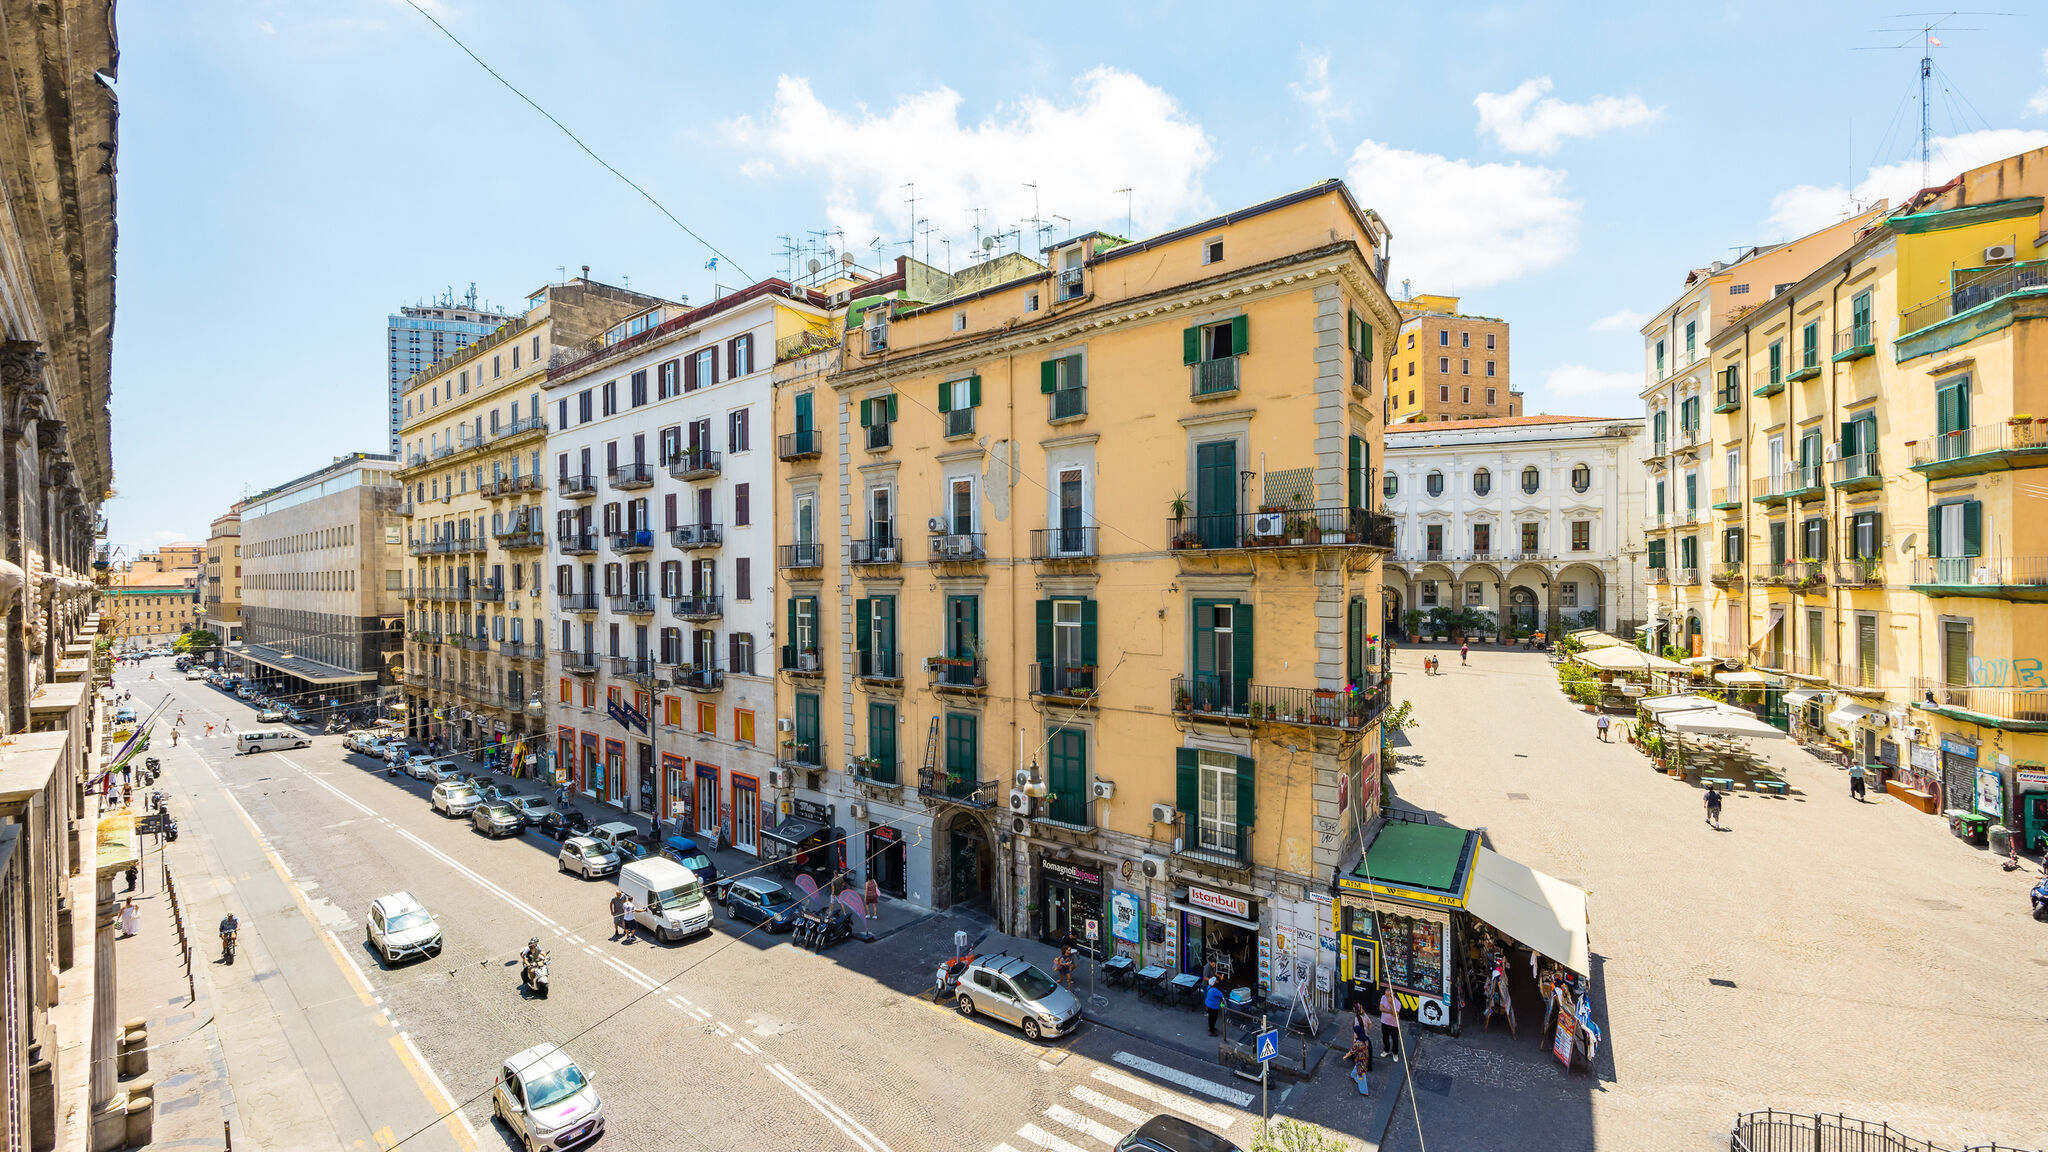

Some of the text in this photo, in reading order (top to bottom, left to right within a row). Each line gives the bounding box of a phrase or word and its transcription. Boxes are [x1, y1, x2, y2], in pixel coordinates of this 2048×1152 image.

[1345, 880, 1361, 889] ATM
[1192, 889, 1236, 909] Istanbul
[1438, 896, 1455, 905] ATM
